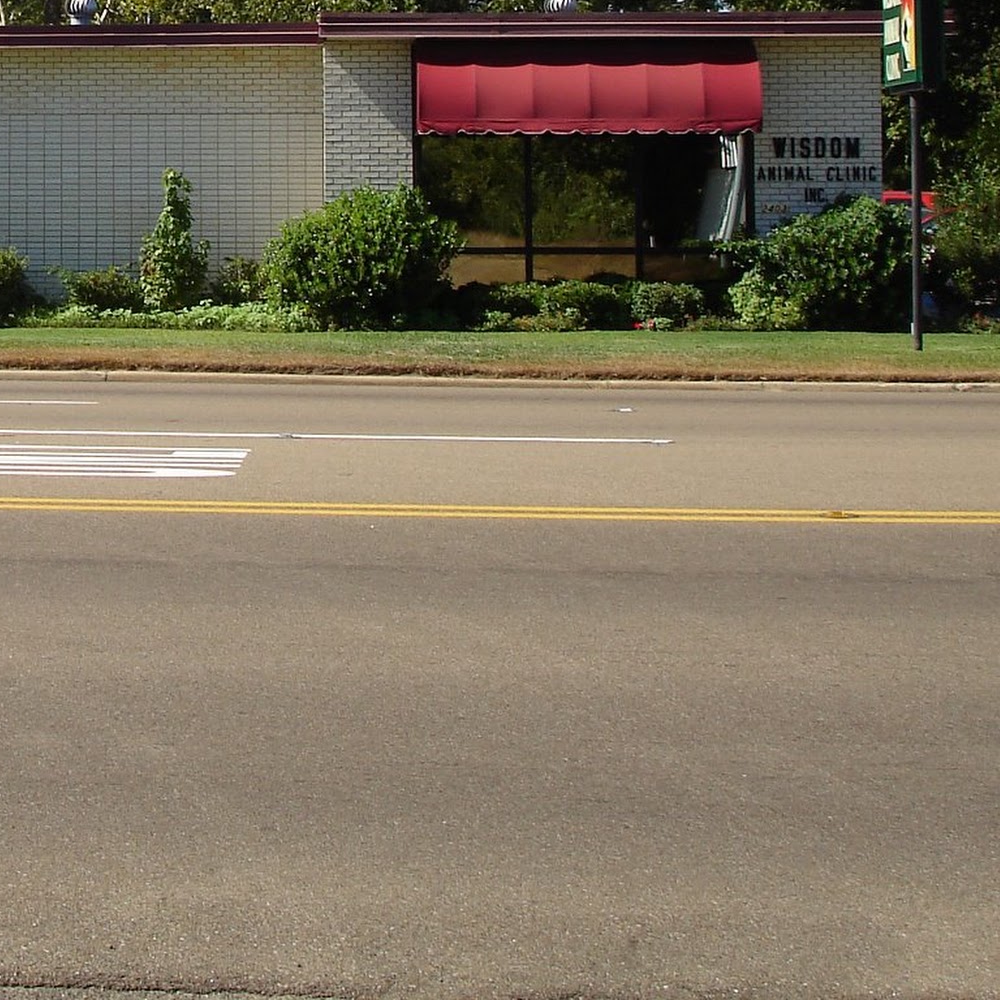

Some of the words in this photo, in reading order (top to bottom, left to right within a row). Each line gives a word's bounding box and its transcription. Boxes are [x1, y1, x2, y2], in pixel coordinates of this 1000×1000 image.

[772, 136, 860, 159] WISDOM
[757, 166, 815, 181] ANIMAL
[826, 166, 877, 181] CLINIC
